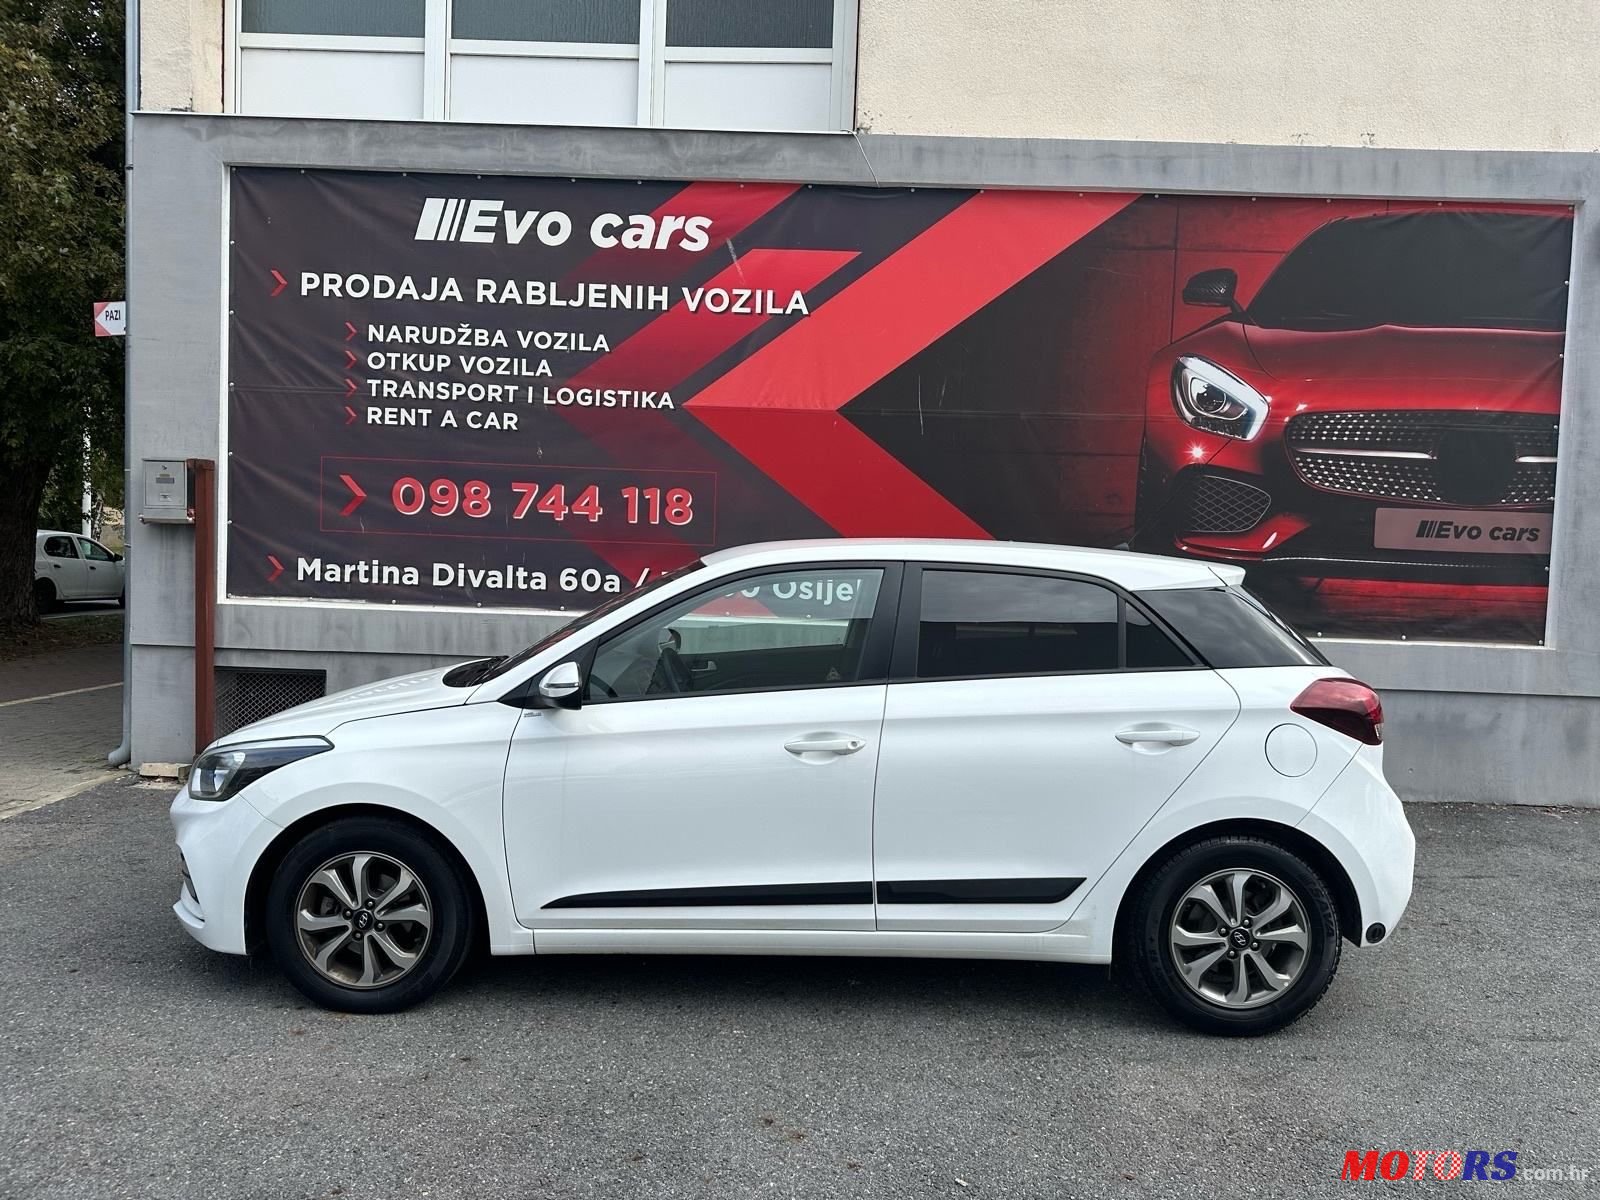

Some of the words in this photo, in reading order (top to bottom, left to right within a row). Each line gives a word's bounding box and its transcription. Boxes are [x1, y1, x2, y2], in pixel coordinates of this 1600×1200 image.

[459, 199, 572, 247] Evo
[589, 212, 712, 252] cars
[300, 271, 464, 302] PRODAJA
[476, 278, 669, 311] RABLJENIH
[681, 286, 809, 315] VOZILA
[105, 310, 121, 320] PAZI
[367, 323, 508, 348] NARUDŽBA
[516, 330, 610, 352] VOZILA
[367, 351, 451, 373] OTKUP
[458, 356, 553, 377] VOZILA
[367, 379, 519, 403] TRANSPORT
[527, 386, 533, 403] I
[543, 387, 675, 410] LOGISTIKA
[367, 407, 433, 427] RENT
[440, 410, 458, 428] A
[466, 411, 519, 430] CAR
[392, 477, 492, 518] 098
[511, 482, 603, 523] 744
[621, 486, 694, 526] 118
[1434, 521, 1481, 540] Evo
[1489, 526, 1540, 542] cars
[297, 557, 419, 585] Martina
[432, 563, 547, 590] Divalta
[559, 568, 621, 593] 60a
